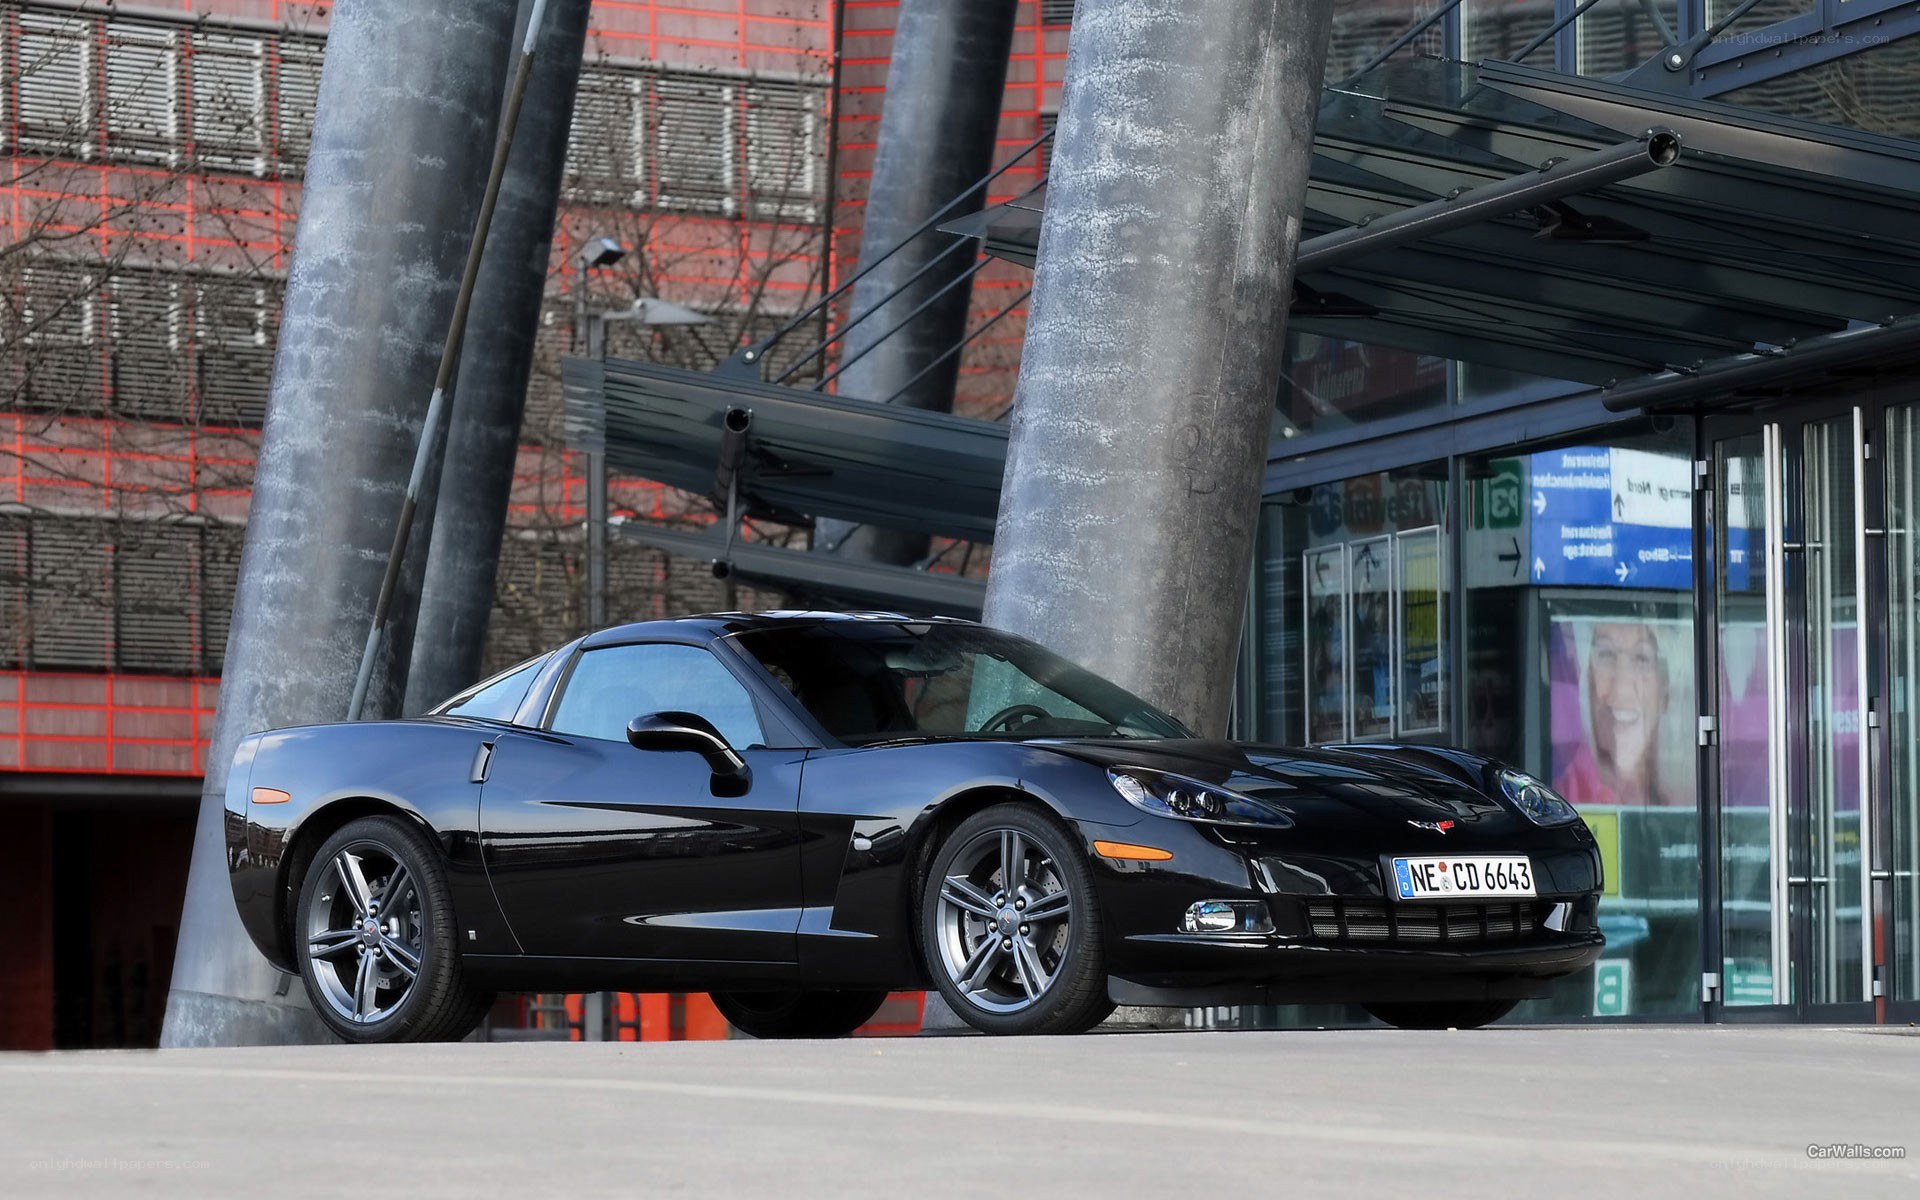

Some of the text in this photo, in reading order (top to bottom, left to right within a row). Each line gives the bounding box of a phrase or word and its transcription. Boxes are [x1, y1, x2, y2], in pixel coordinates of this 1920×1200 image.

[1410, 862, 1531, 892] NE CD 6643
